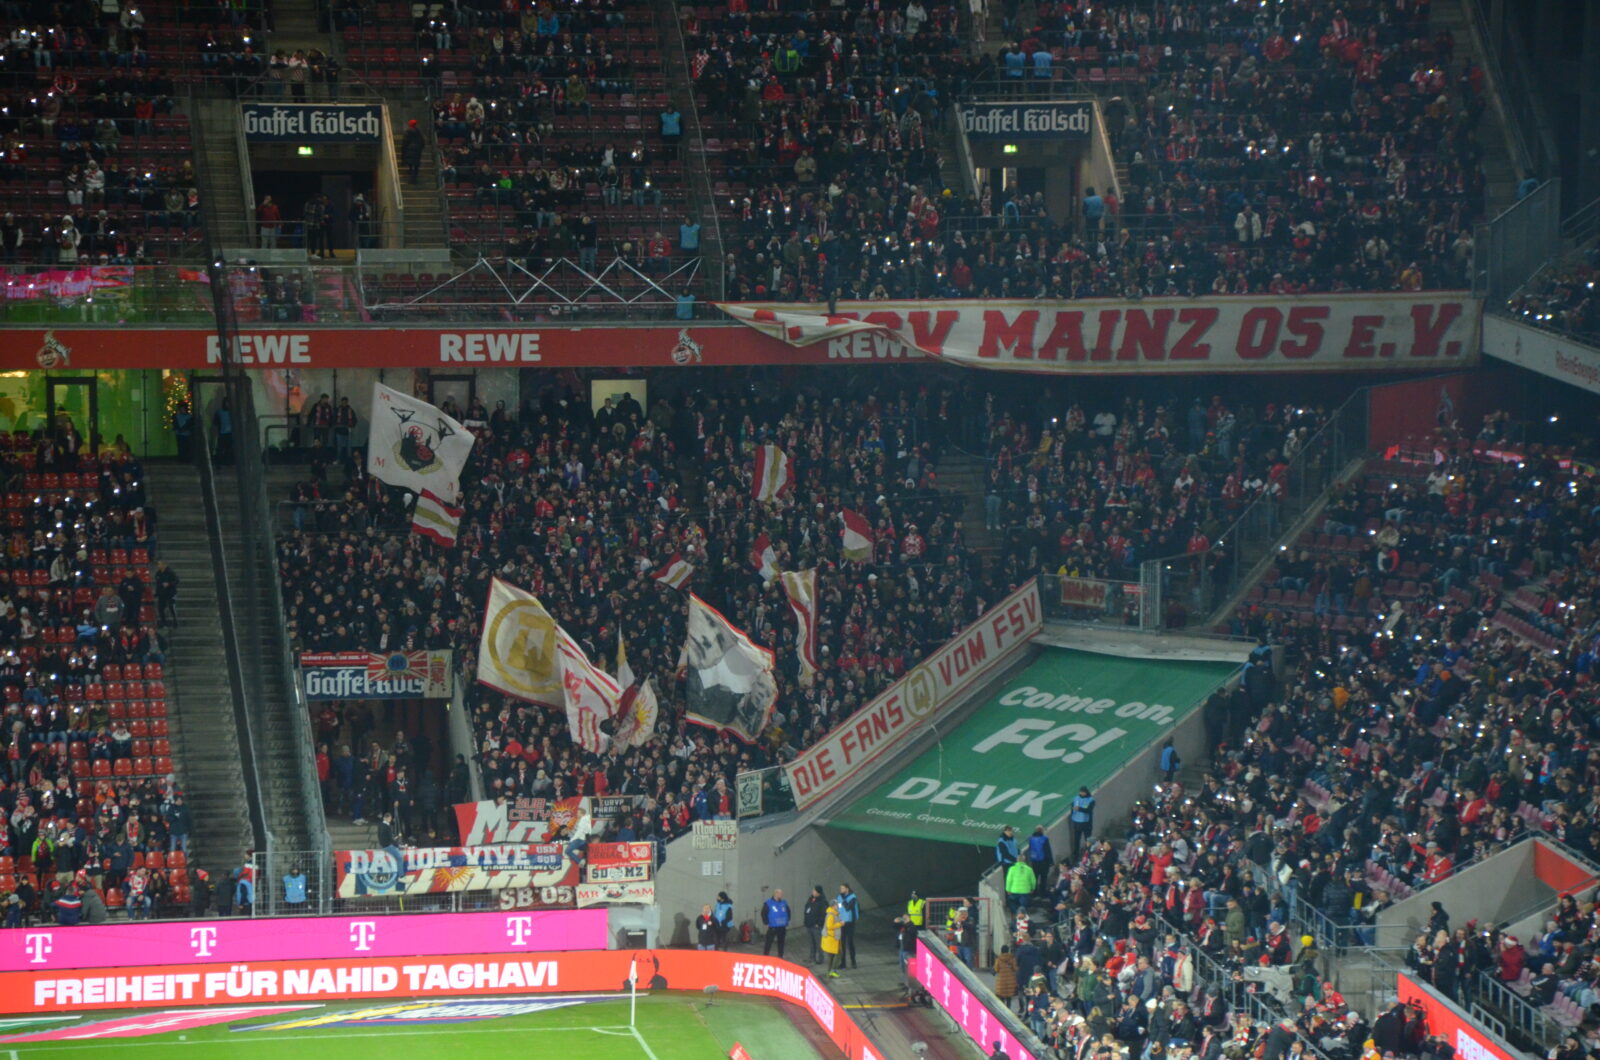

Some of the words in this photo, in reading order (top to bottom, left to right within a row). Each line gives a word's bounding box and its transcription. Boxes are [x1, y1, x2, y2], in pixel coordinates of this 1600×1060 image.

[244, 107, 307, 136] Gaffel
[310, 110, 379, 137] Kölsch
[962, 107, 1020, 134] Gaffel
[440, 333, 541, 362] REWE
[978, 307, 1220, 360] MAINZ
[1236, 306, 1331, 359] 05
[207, 335, 311, 363] REWE
[792, 747, 836, 797] DIE
[840, 695, 904, 765] FANS
[938, 631, 986, 687] VOM
[992, 591, 1037, 649] FSV
[999, 686, 1115, 714] Come
[972, 718, 1128, 764] FC!
[886, 777, 1063, 817] DEVK
[464, 845, 529, 866] VIVE
[34, 973, 200, 1006] FREIHEIT
[205, 965, 277, 998] FÜR
[283, 966, 398, 995] NAHID
[403, 961, 558, 990] TAGHAVI
